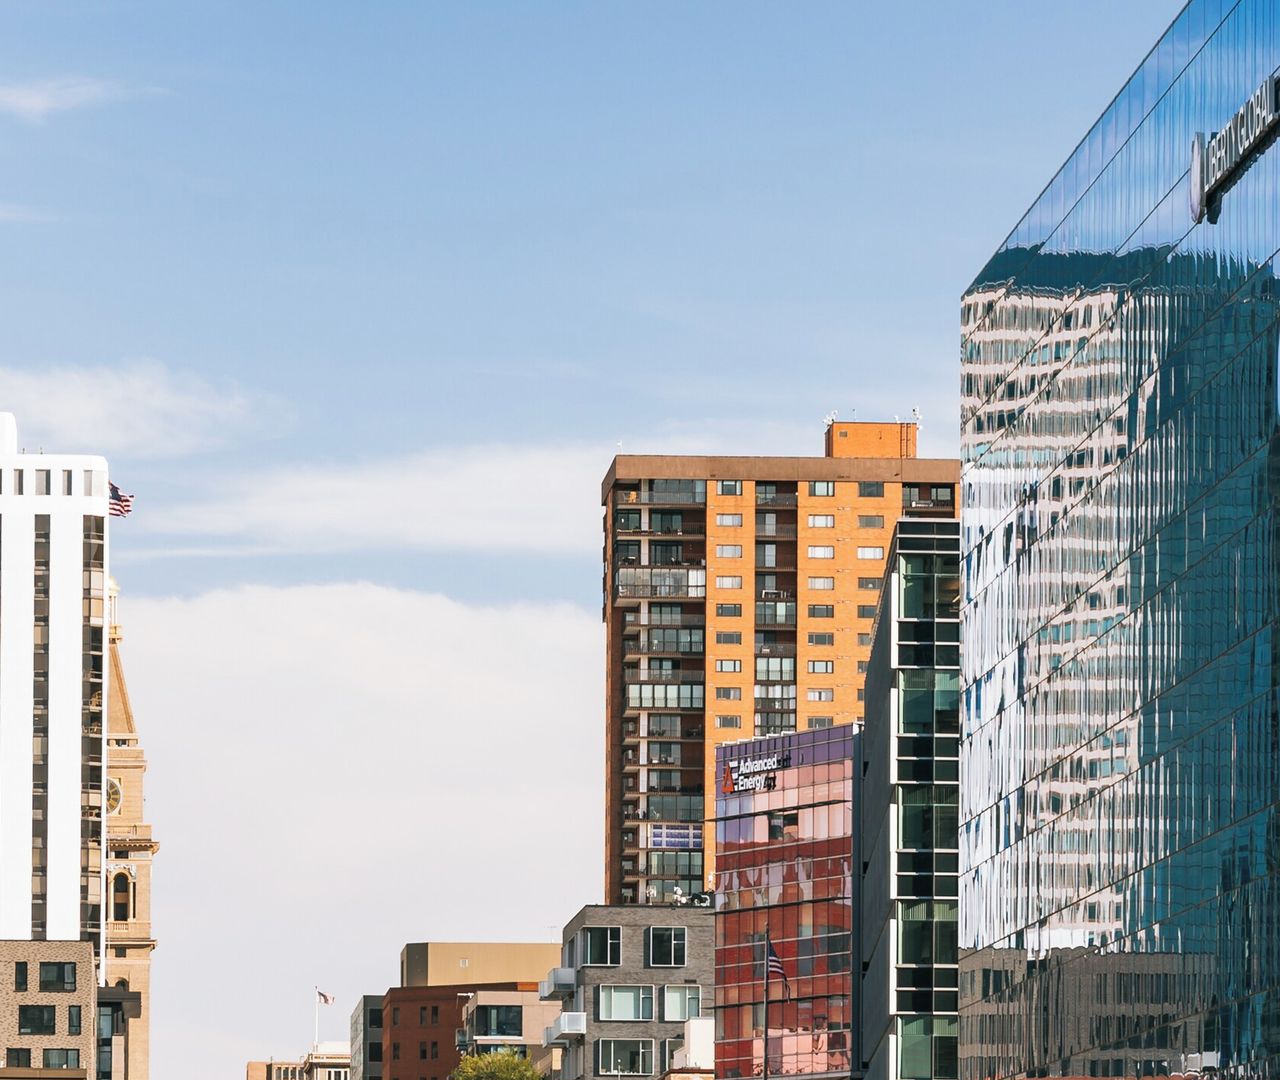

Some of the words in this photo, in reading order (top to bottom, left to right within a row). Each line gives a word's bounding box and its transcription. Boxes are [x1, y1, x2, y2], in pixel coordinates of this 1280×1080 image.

[1204, 116, 1236, 193] LIBERTY
[1237, 78, 1273, 155] GLOBAL
[739, 753, 777, 774] Advanced
[738, 773, 766, 791] Energy
